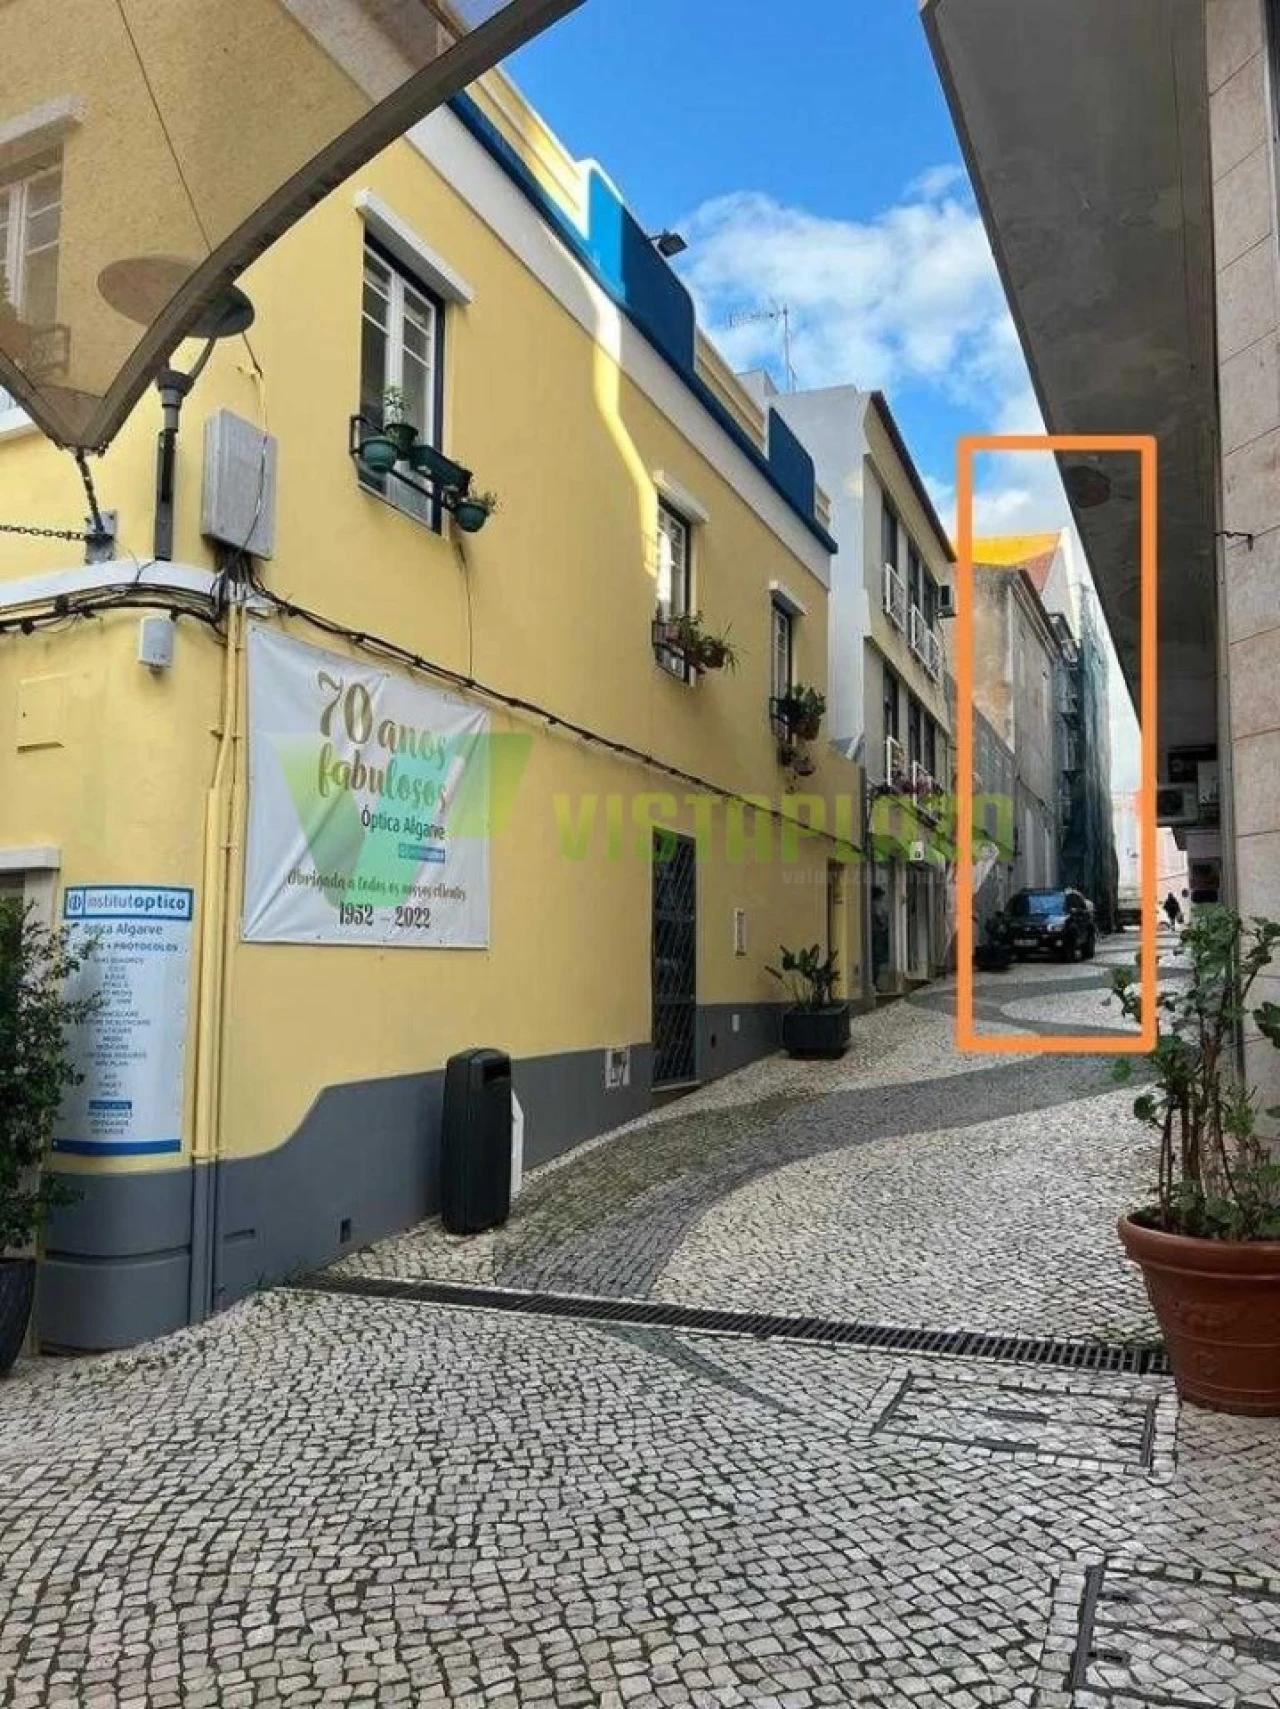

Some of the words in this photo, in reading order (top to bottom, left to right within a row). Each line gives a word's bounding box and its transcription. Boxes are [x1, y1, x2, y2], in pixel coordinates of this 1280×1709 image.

[318, 670, 373, 745] 70
[378, 718, 446, 770] anos
[319, 741, 447, 813] fabulosos
[361, 804, 400, 833] Óptica
[402, 815, 446, 841] Algarve
[116, 922, 163, 937] Algarve
[339, 902, 374, 926] 1952
[395, 905, 431, 928] 2022
